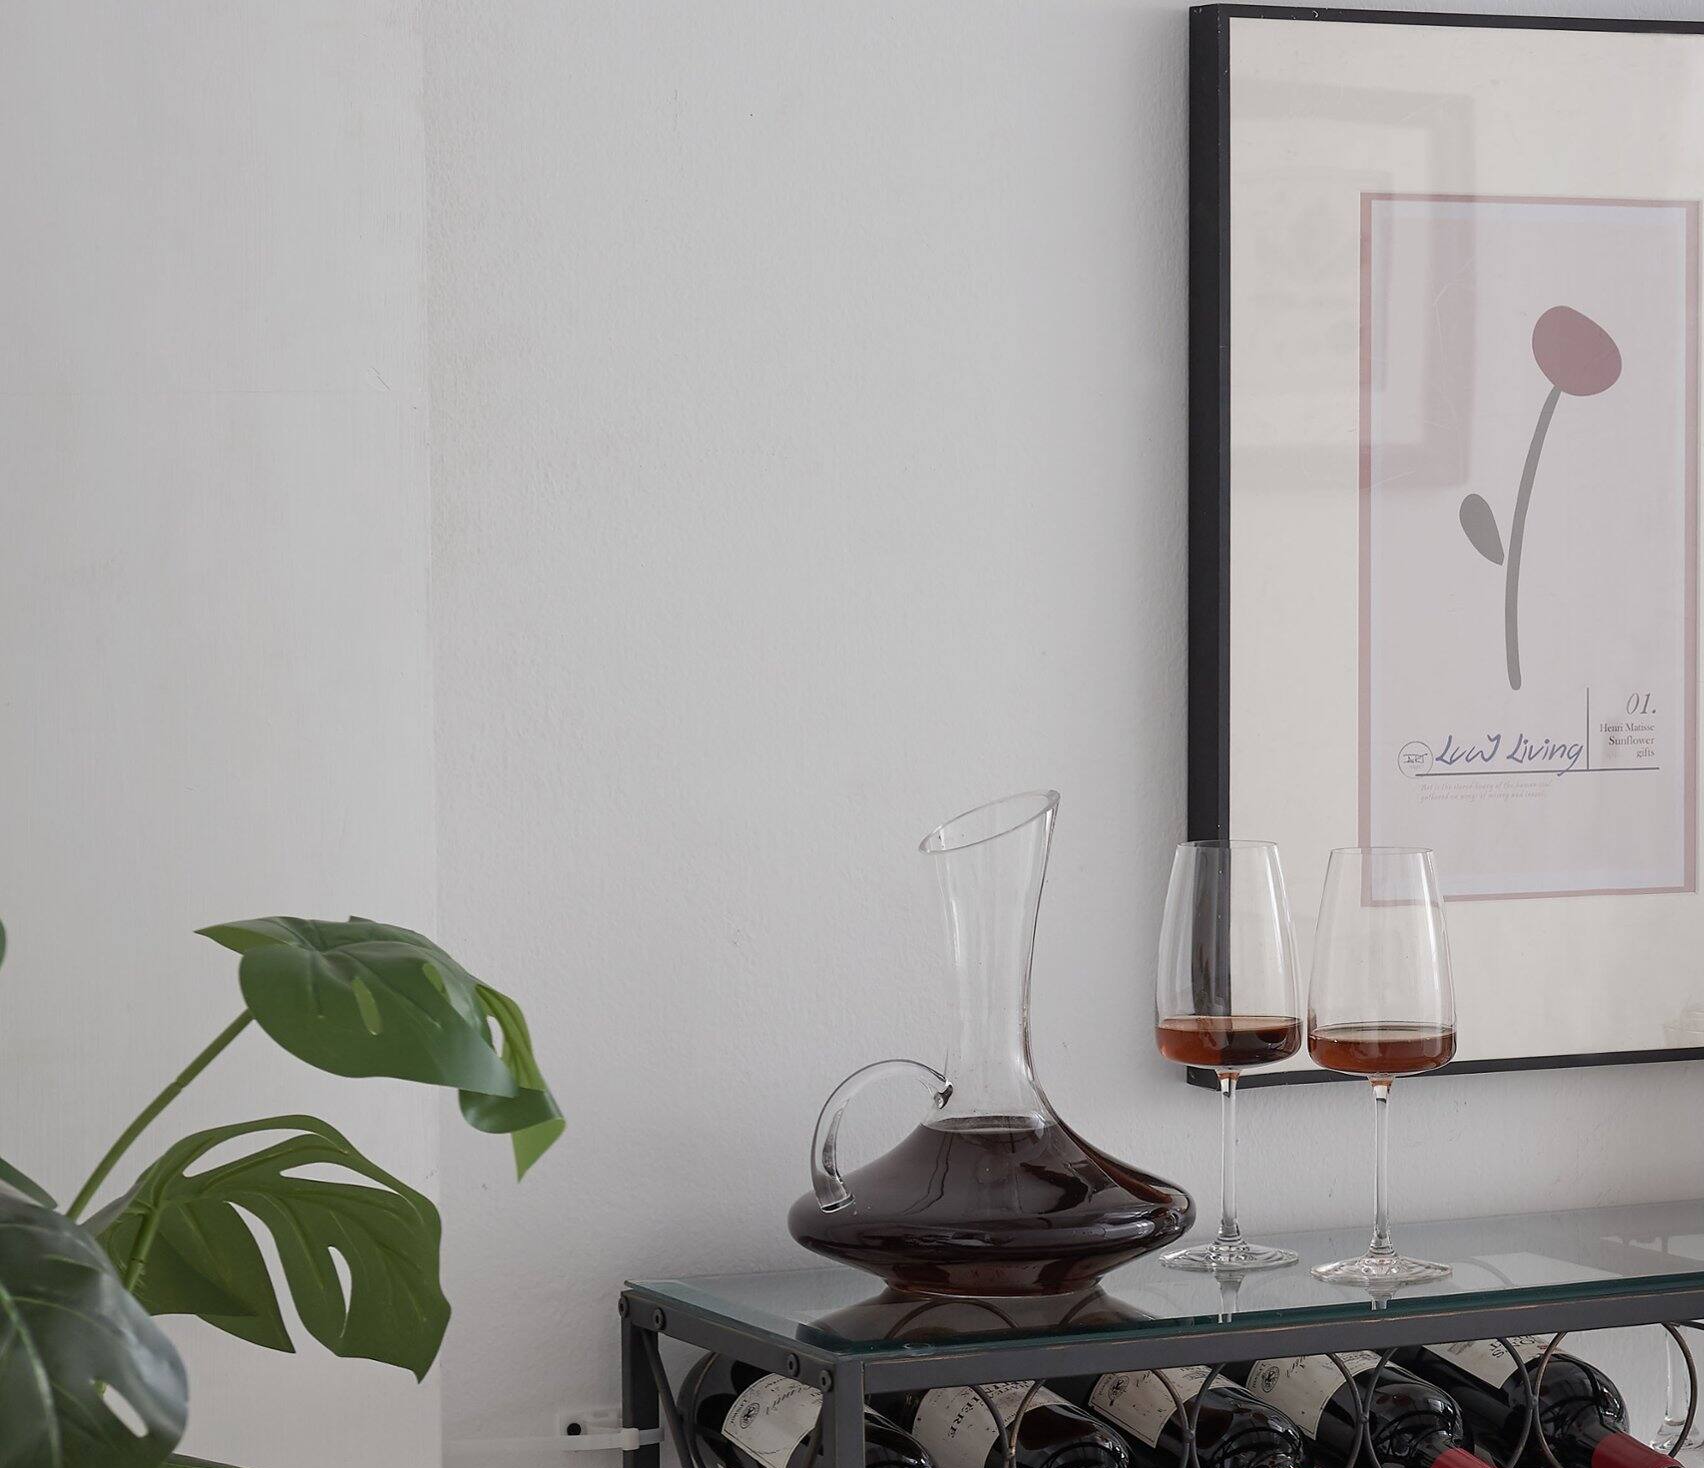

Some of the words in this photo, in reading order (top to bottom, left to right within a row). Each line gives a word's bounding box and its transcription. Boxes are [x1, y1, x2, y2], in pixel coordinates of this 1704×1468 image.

[1626, 692, 1657, 715] 01.
[1608, 735, 1656, 746] Sunflower
[1506, 733, 1584, 777] Living
